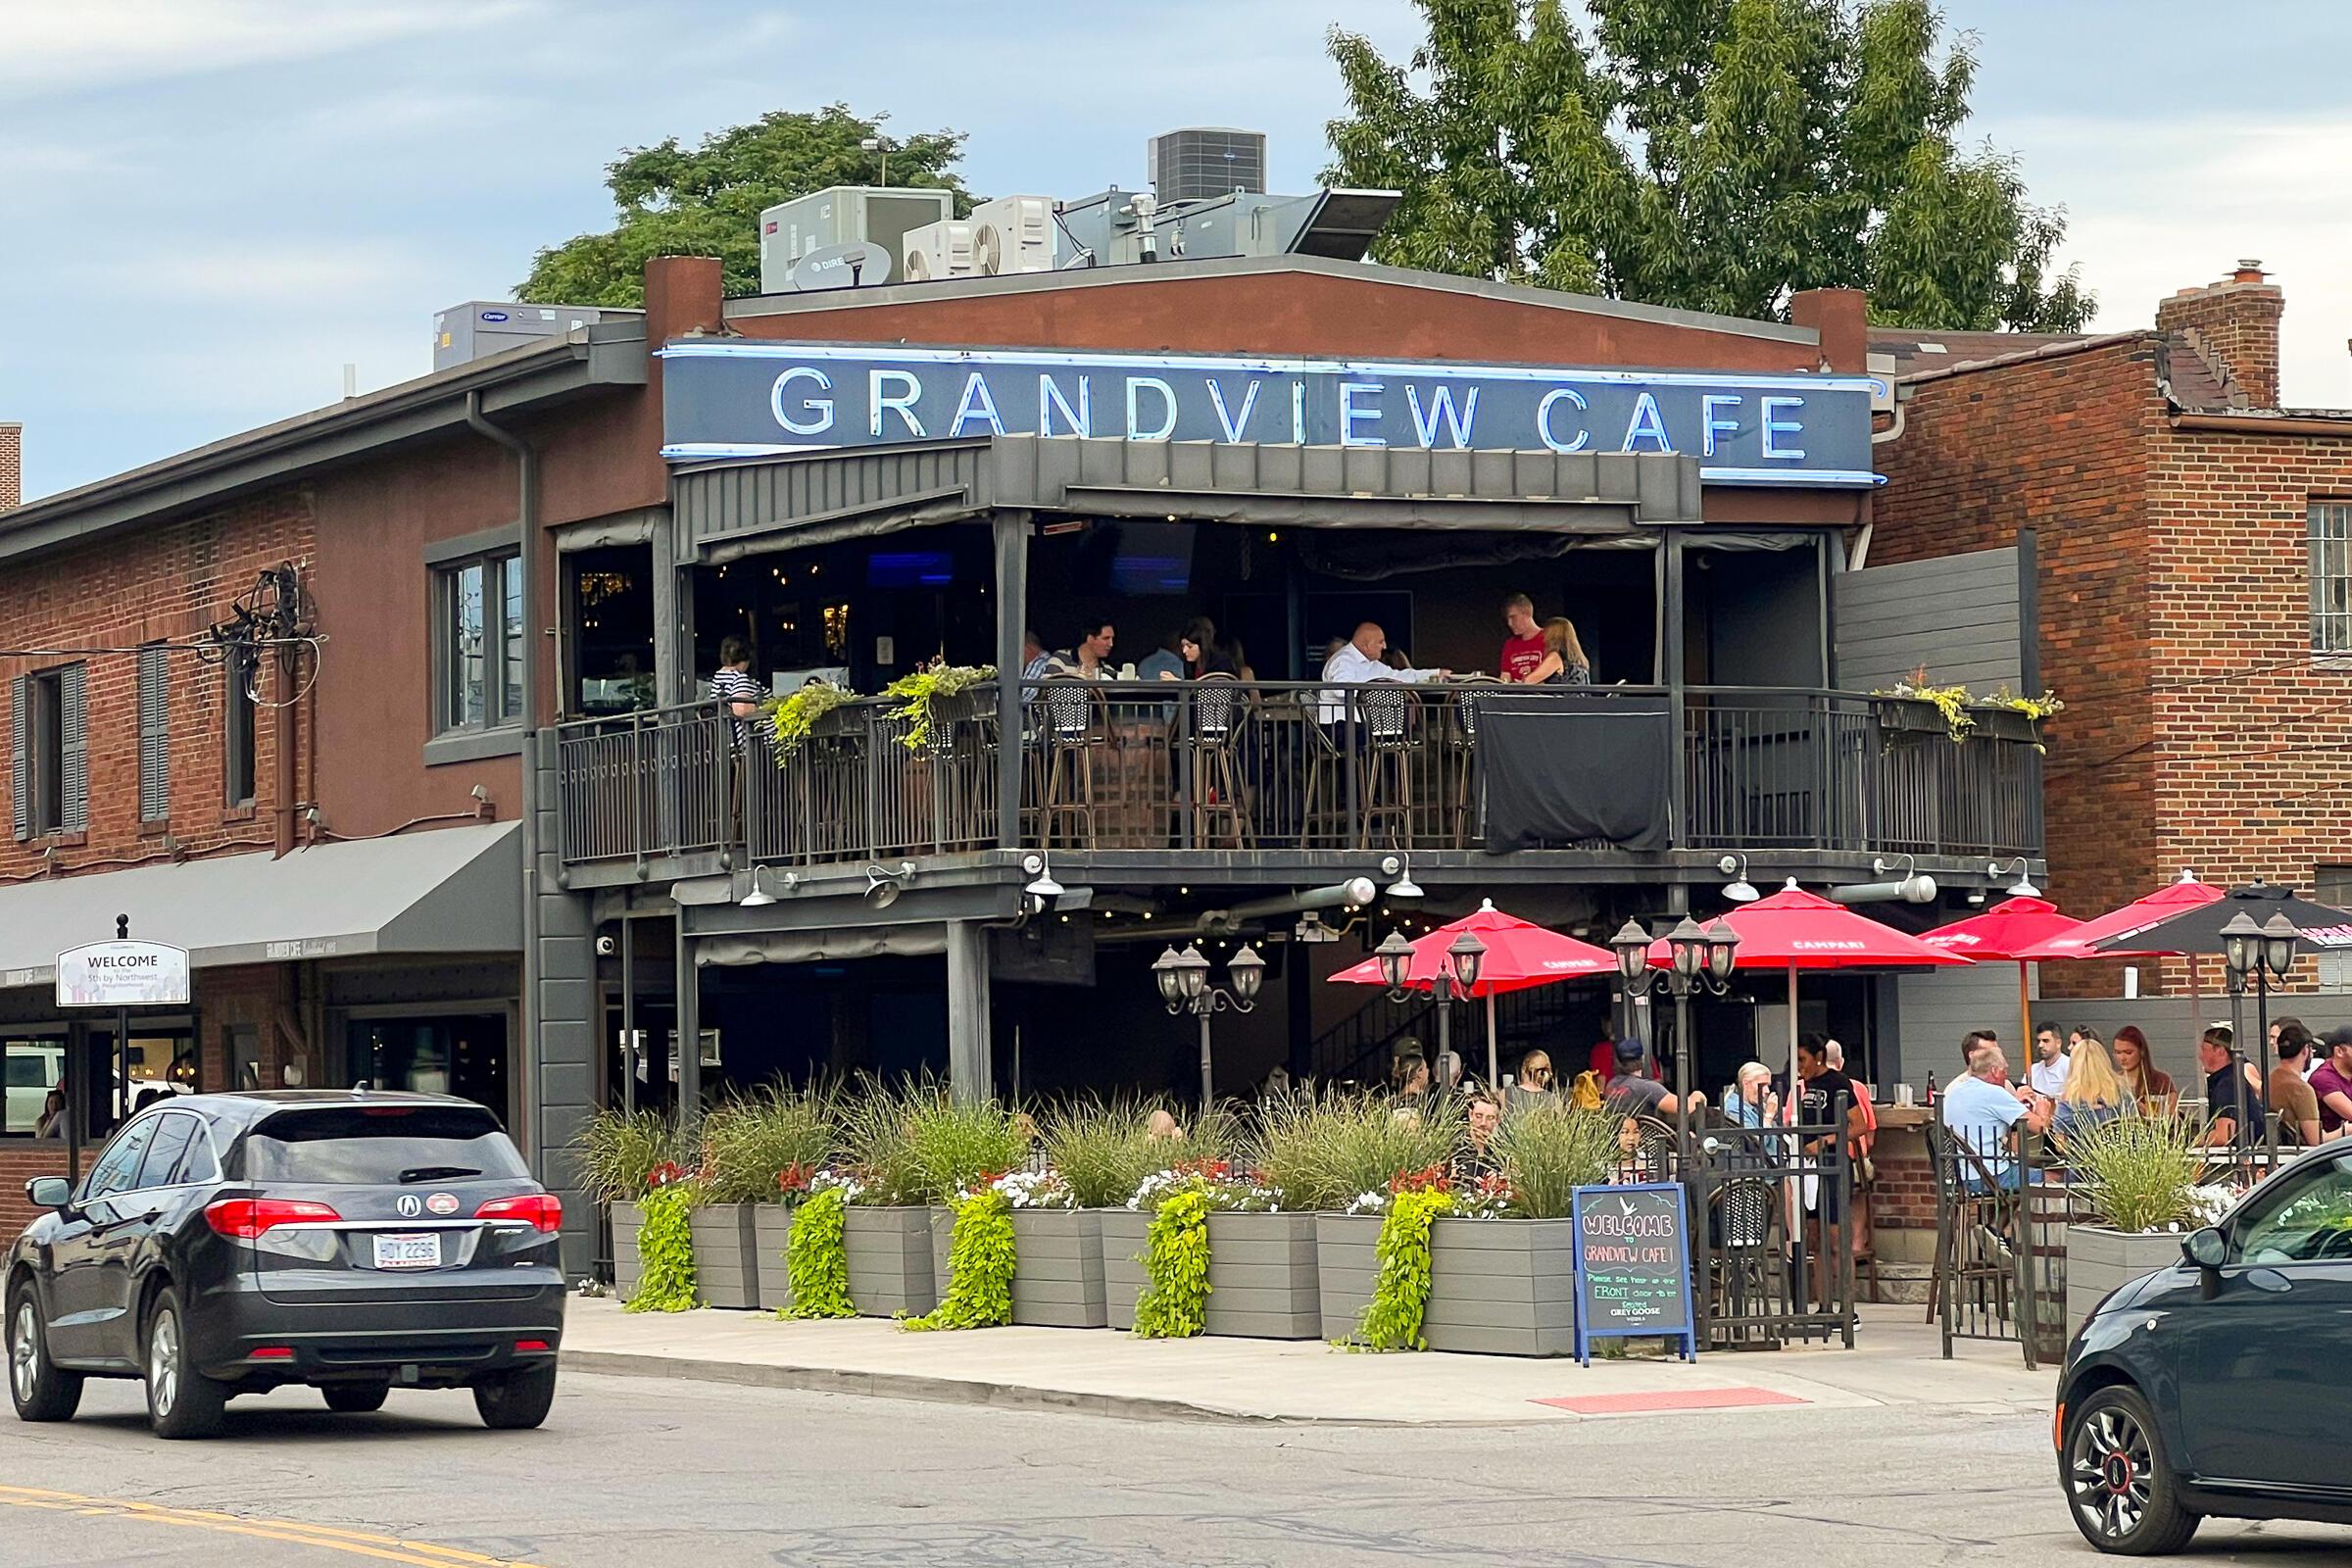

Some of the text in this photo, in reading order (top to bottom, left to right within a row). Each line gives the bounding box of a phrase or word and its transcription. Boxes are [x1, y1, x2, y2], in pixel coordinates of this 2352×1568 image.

[770, 367, 1805, 460] GRANDVIEW CAFE
[1791, 940, 1866, 950] CAMPARI
[87, 956, 158, 968] WELCOME
[103, 973, 114, 984] by
[116, 973, 158, 982] Northwest
[1582, 1214, 1674, 1237] WELCOME
[1584, 1245, 1639, 1263] GRANDVIEW
[1594, 1286, 1629, 1298] FRONT
